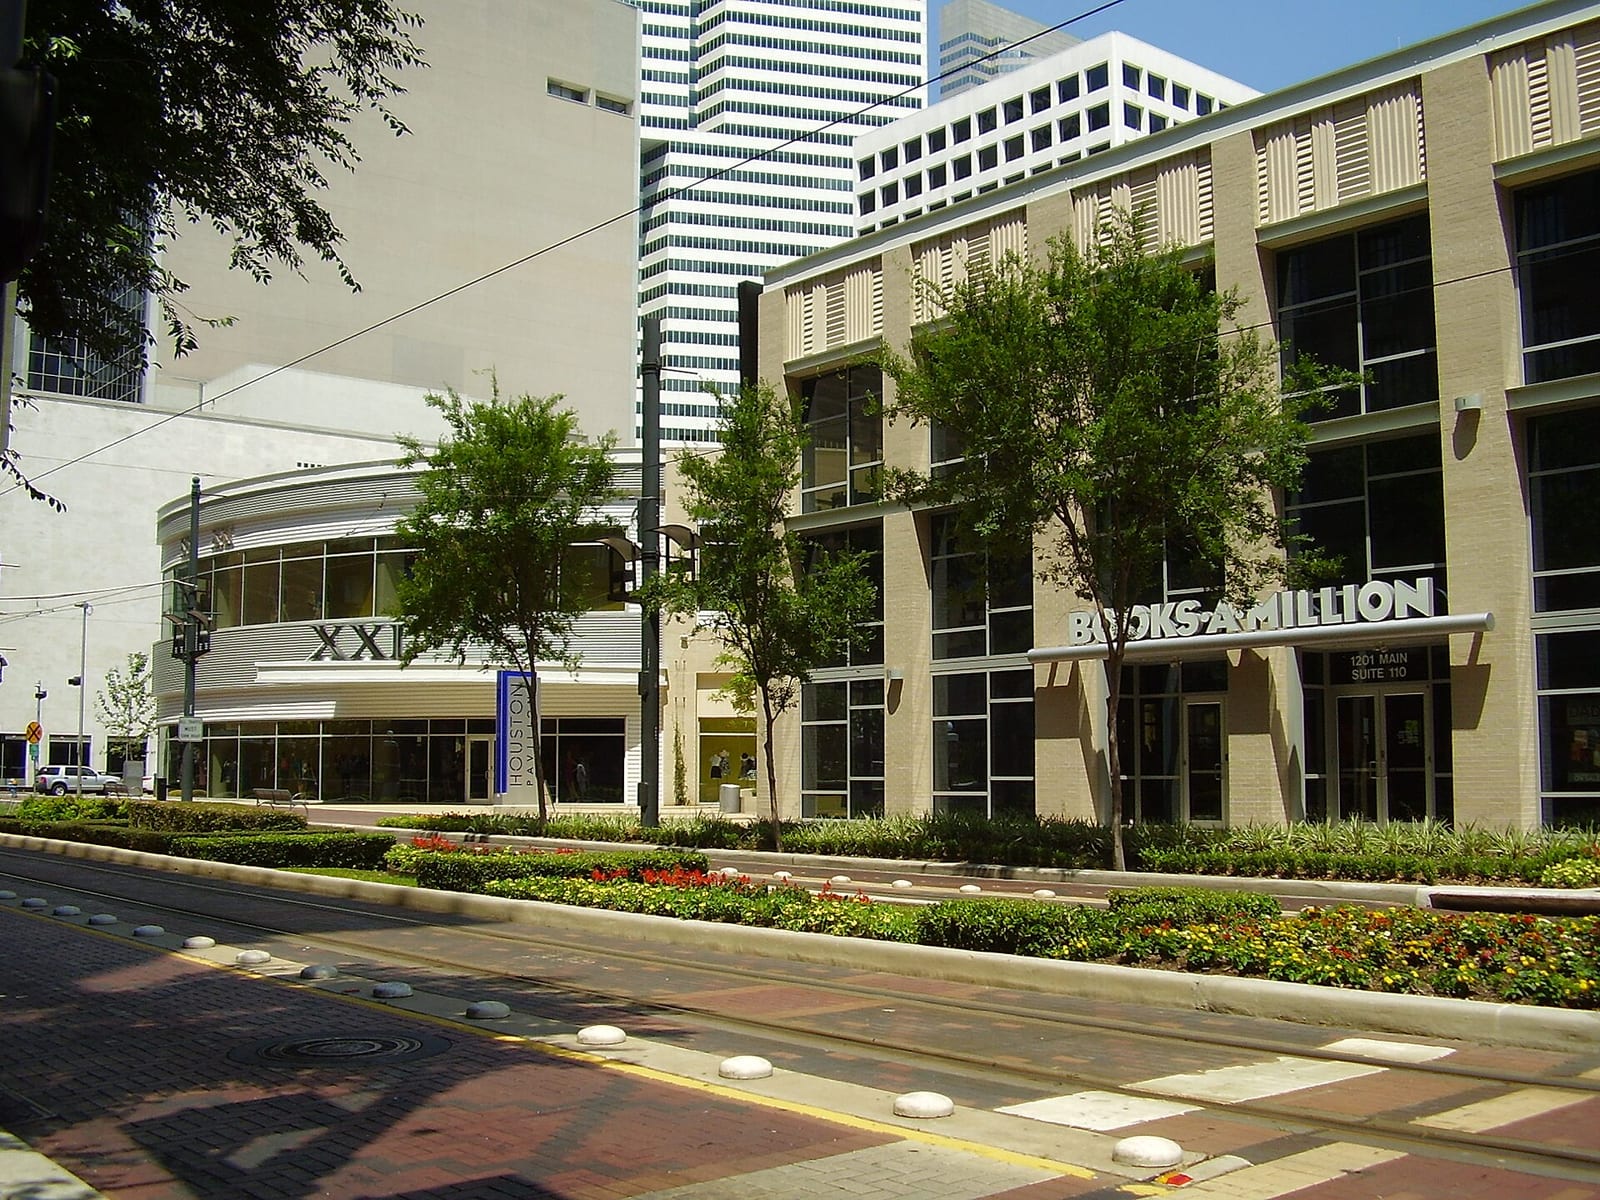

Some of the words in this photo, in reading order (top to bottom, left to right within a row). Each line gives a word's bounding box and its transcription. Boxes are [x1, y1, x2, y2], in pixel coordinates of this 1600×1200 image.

[1350, 654, 1375, 667] 1201
[1379, 652, 1408, 665] MAIN
[1351, 667, 1385, 680] SUITE
[1389, 666, 1407, 678] 110
[510, 683, 523, 786] HOUSTON
